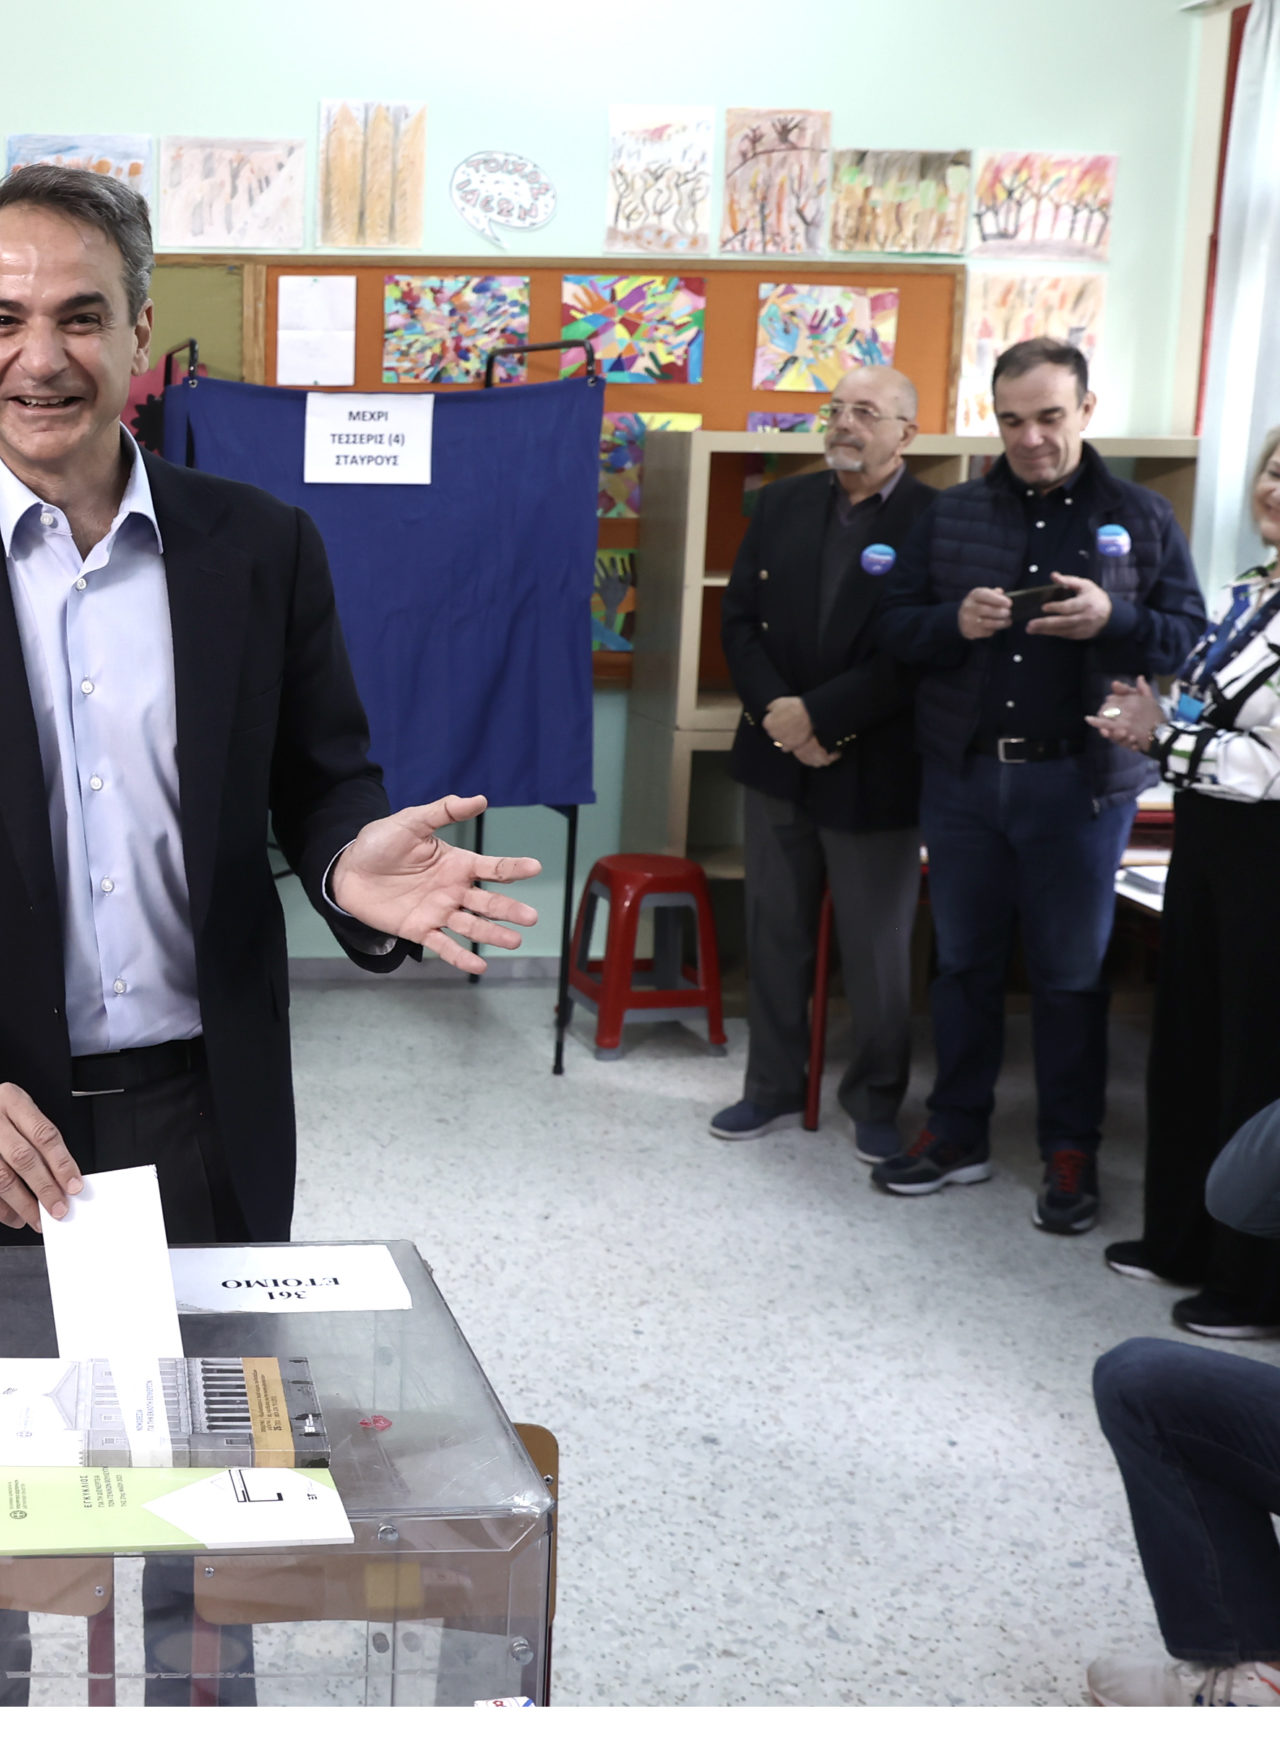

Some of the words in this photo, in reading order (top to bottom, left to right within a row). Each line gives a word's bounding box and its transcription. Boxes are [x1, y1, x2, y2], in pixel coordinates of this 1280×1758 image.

[456, 178, 539, 221] ΙΔΕΩΝ
[348, 411, 389, 422] ΜΕΧΡΙ
[330, 433, 385, 445] ΤΕΣΣΕΡΙΣ
[388, 433, 405, 447] (4)
[335, 455, 399, 466] ΣΤΑΥΡΟΥΣ
[221, 1277, 340, 1289] ΕΤΟΙΜΟ
[268, 1291, 307, 1300] 361
[80, 1475, 92, 1508] ΕΓΚΥΚΛΙΟΣ
